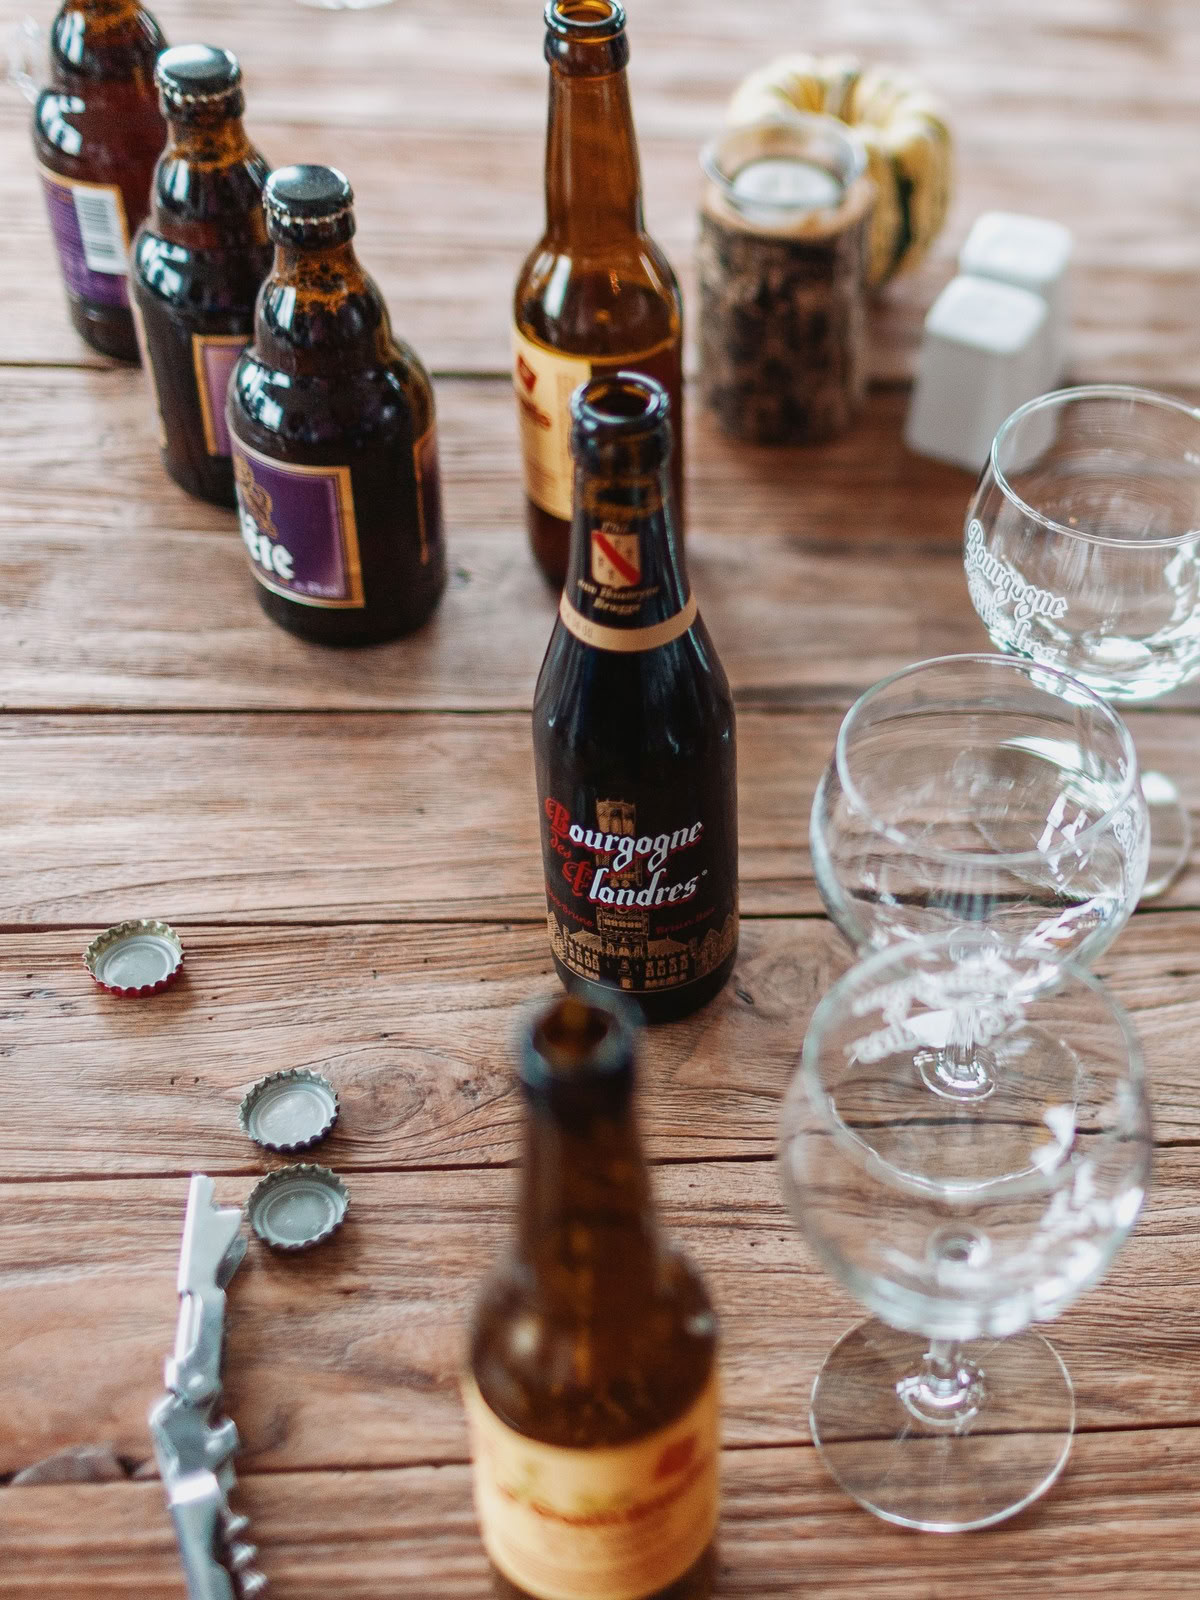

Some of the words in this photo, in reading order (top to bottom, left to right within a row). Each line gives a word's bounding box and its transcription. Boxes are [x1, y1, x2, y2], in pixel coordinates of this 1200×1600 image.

[967, 519, 1068, 620] Bourgogne
[545, 797, 703, 873] Bourgogne
[562, 861, 700, 908] Flandres
